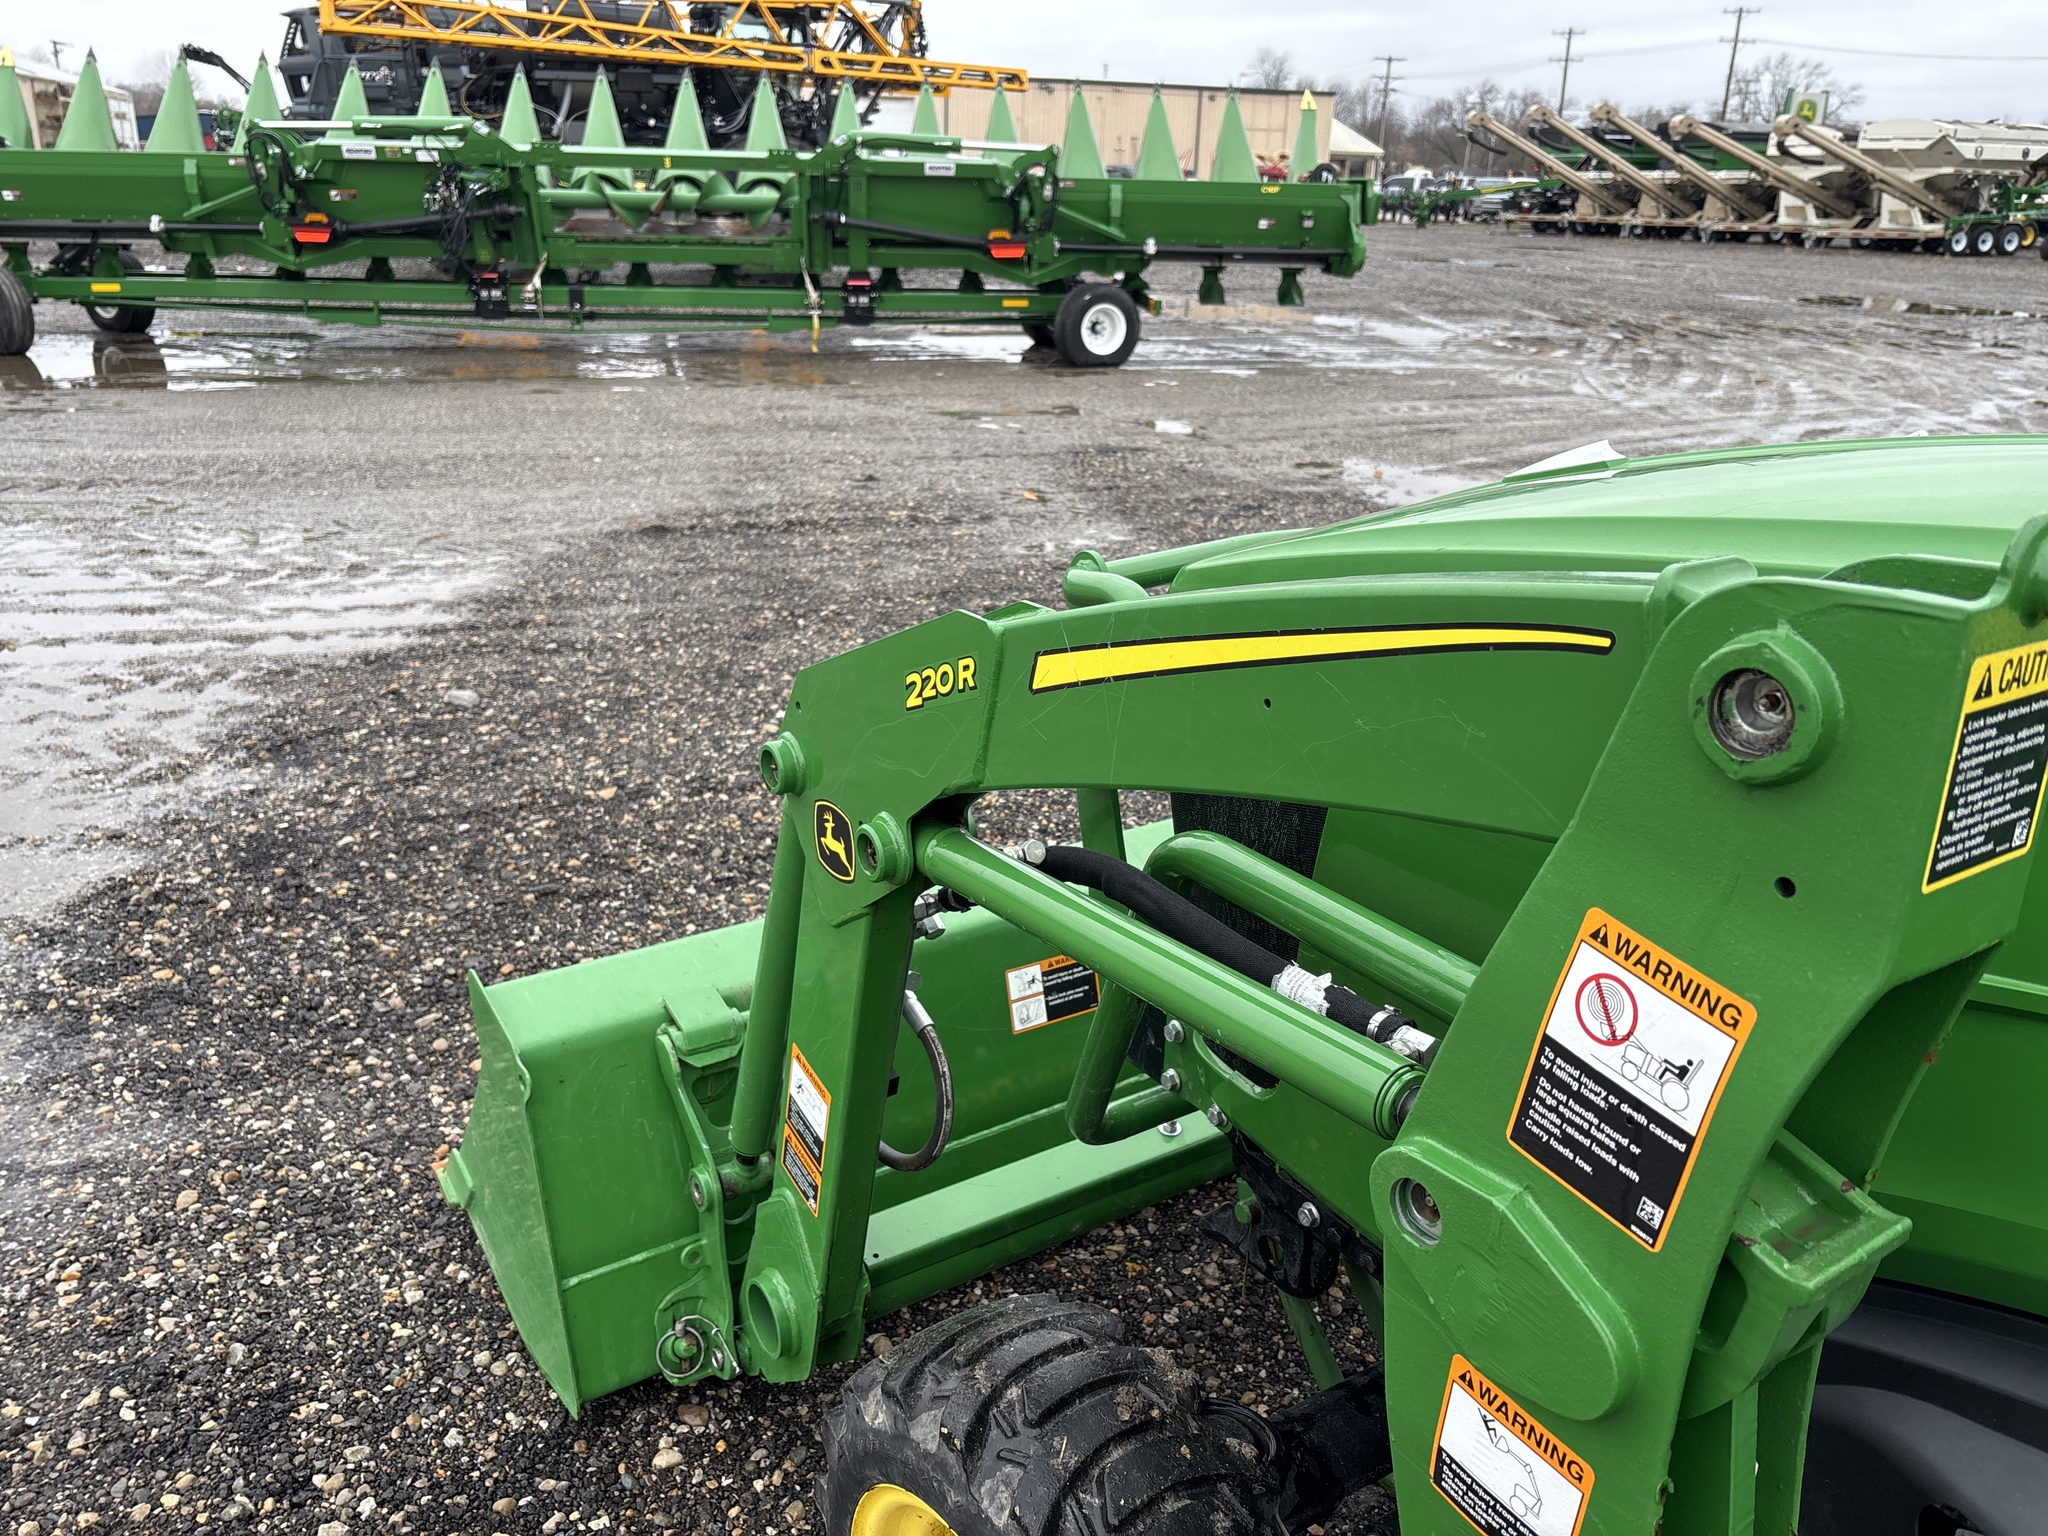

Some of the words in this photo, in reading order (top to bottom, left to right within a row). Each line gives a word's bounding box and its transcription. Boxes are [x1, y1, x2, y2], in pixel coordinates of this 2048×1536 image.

[905, 656, 977, 711] 220R
[1998, 647, 2048, 693] CAUTI
[1964, 727, 1997, 746] operating.
[1968, 717, 1983, 730] Lock
[1985, 712, 2006, 724] loader
[2007, 705, 2029, 717] latches
[2031, 699, 2047, 711] befor
[1959, 751, 1993, 769] equipment
[1994, 749, 2001, 757] or
[2002, 735, 2044, 755] disconnecting
[1962, 743, 1983, 756] Before
[2016, 723, 2044, 739] adjusting
[1956, 805, 1971, 817] Shut
[1972, 801, 1982, 811] off
[1983, 795, 2003, 807] engine
[2005, 788, 2016, 799] and
[2017, 782, 2036, 795] relieve
[1958, 797, 1965, 805] or
[1967, 786, 1991, 801] support
[1962, 779, 1981, 792] Lower
[1983, 772, 2003, 784] loader
[2012, 759, 2034, 776] ground
[1941, 830, 1968, 845] Observe
[1970, 822, 1989, 835] safety
[1952, 813, 1981, 830] hydraulic
[1964, 831, 1985, 848] loader
[1615, 932, 1741, 1030] WARNING
[1540, 1055, 1551, 1069] by
[1552, 1064, 1578, 1090] falling
[1580, 1084, 1608, 1109] loads:
[1544, 1046, 1554, 1059] To
[1555, 1057, 1579, 1078] avoid
[1580, 1073, 1606, 1098] injury
[1608, 1095, 1619, 1105] or
[1649, 1123, 1686, 1152] caused
[1529, 1109, 1561, 1137] caution.
[1535, 1085, 1556, 1106] large
[1558, 1104, 1589, 1129] square
[1590, 1125, 1616, 1150] bales.
[1538, 1076, 1550, 1090] Do
[1552, 1088, 1566, 1102] not
[1568, 1098, 1598, 1125] handle
[1600, 1122, 1628, 1146] round
[1629, 1144, 1641, 1154] or
[1525, 1119, 1548, 1141] Carry
[1549, 1137, 1573, 1159] loads
[1575, 1155, 1592, 1174] low.
[1531, 1098, 1561, 1125] Handle
[1562, 1123, 1590, 1146] raised
[1591, 1142, 1616, 1166] loads
[1619, 1163, 1639, 1182] with
[1479, 1380, 1583, 1483] WARNING
[1441, 1451, 1450, 1464] To
[1452, 1464, 1472, 1485] avoid
[1473, 1482, 1495, 1505] injury
[1496, 1502, 1515, 1524] from
[1441, 1480, 1487, 1528] attachments.
[1442, 1473, 1462, 1496] riders
[1464, 1495, 1474, 1506] on
[1475, 1503, 1500, 1529] loader
[1443, 1465, 1453, 1478] Do
[1454, 1477, 1467, 1492] not
[1468, 1490, 1487, 1510] work
[1488, 1508, 1506, 1528] from
[1507, 1527, 1517, 1536] or
